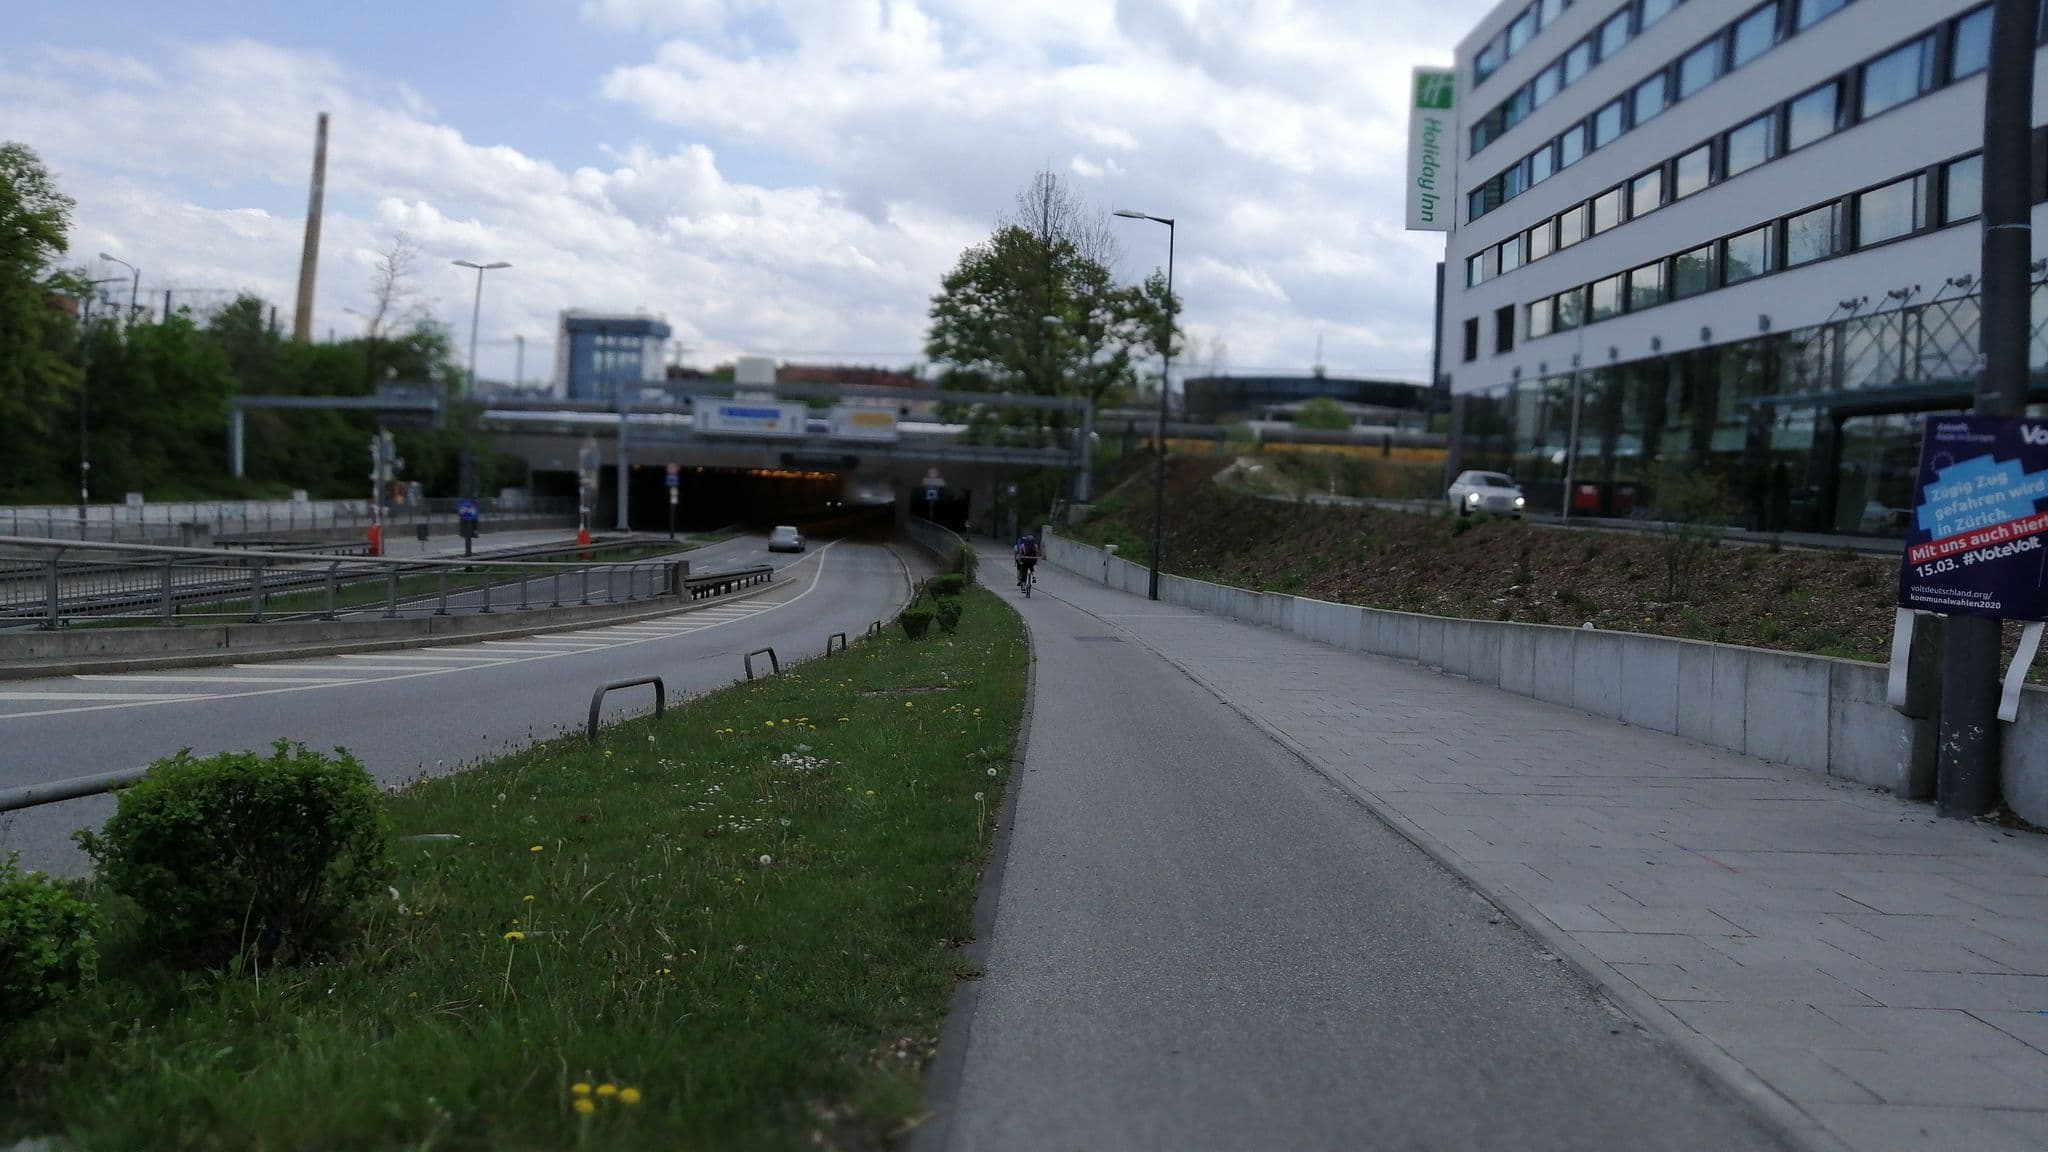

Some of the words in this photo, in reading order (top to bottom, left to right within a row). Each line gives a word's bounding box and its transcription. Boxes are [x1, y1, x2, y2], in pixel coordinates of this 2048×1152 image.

[1417, 117, 1442, 191] Holiday
[1421, 193, 1440, 223] Inn
[1976, 471, 2009, 488] Zug
[1935, 490, 2005, 521] gefahren
[2010, 479, 2045, 498] wird
[1937, 521, 1952, 536] in
[1955, 507, 2012, 532] Zürich.
[1912, 544, 1936, 562] Mit
[1941, 538, 1967, 555] uns
[1970, 525, 2010, 546] auch
[1915, 557, 1960, 579] 15.03.
[1962, 536, 2042, 566] #VoteVolt
[1910, 584, 1993, 600] voltdeutschland.org/
[1910, 593, 2001, 610] kommunalwahlen2020
